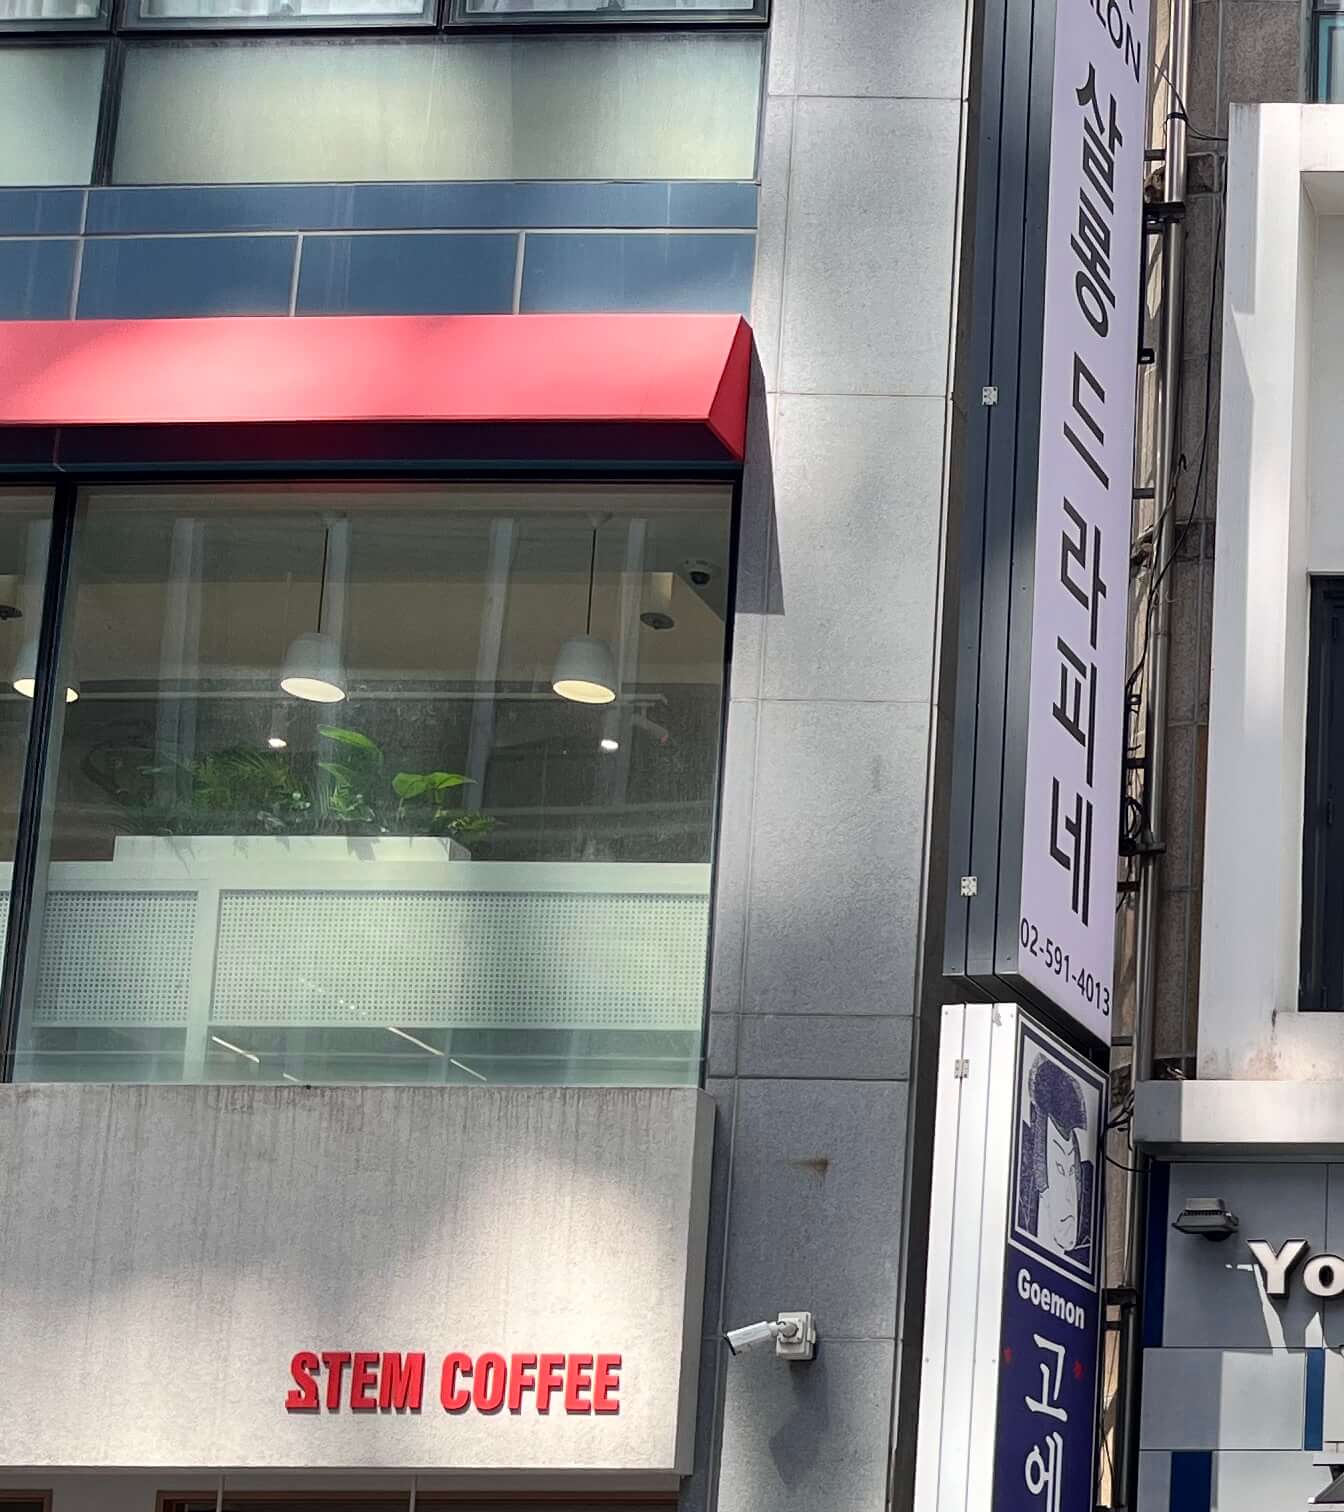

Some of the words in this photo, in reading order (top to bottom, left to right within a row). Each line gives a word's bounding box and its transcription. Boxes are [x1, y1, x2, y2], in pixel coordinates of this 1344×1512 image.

[1020, 916, 1111, 1017] 02-591-4013
[1017, 1268, 1085, 1330] Goemon
[285, 1351, 427, 1415] STEM
[439, 1352, 623, 1416] COFFEE
